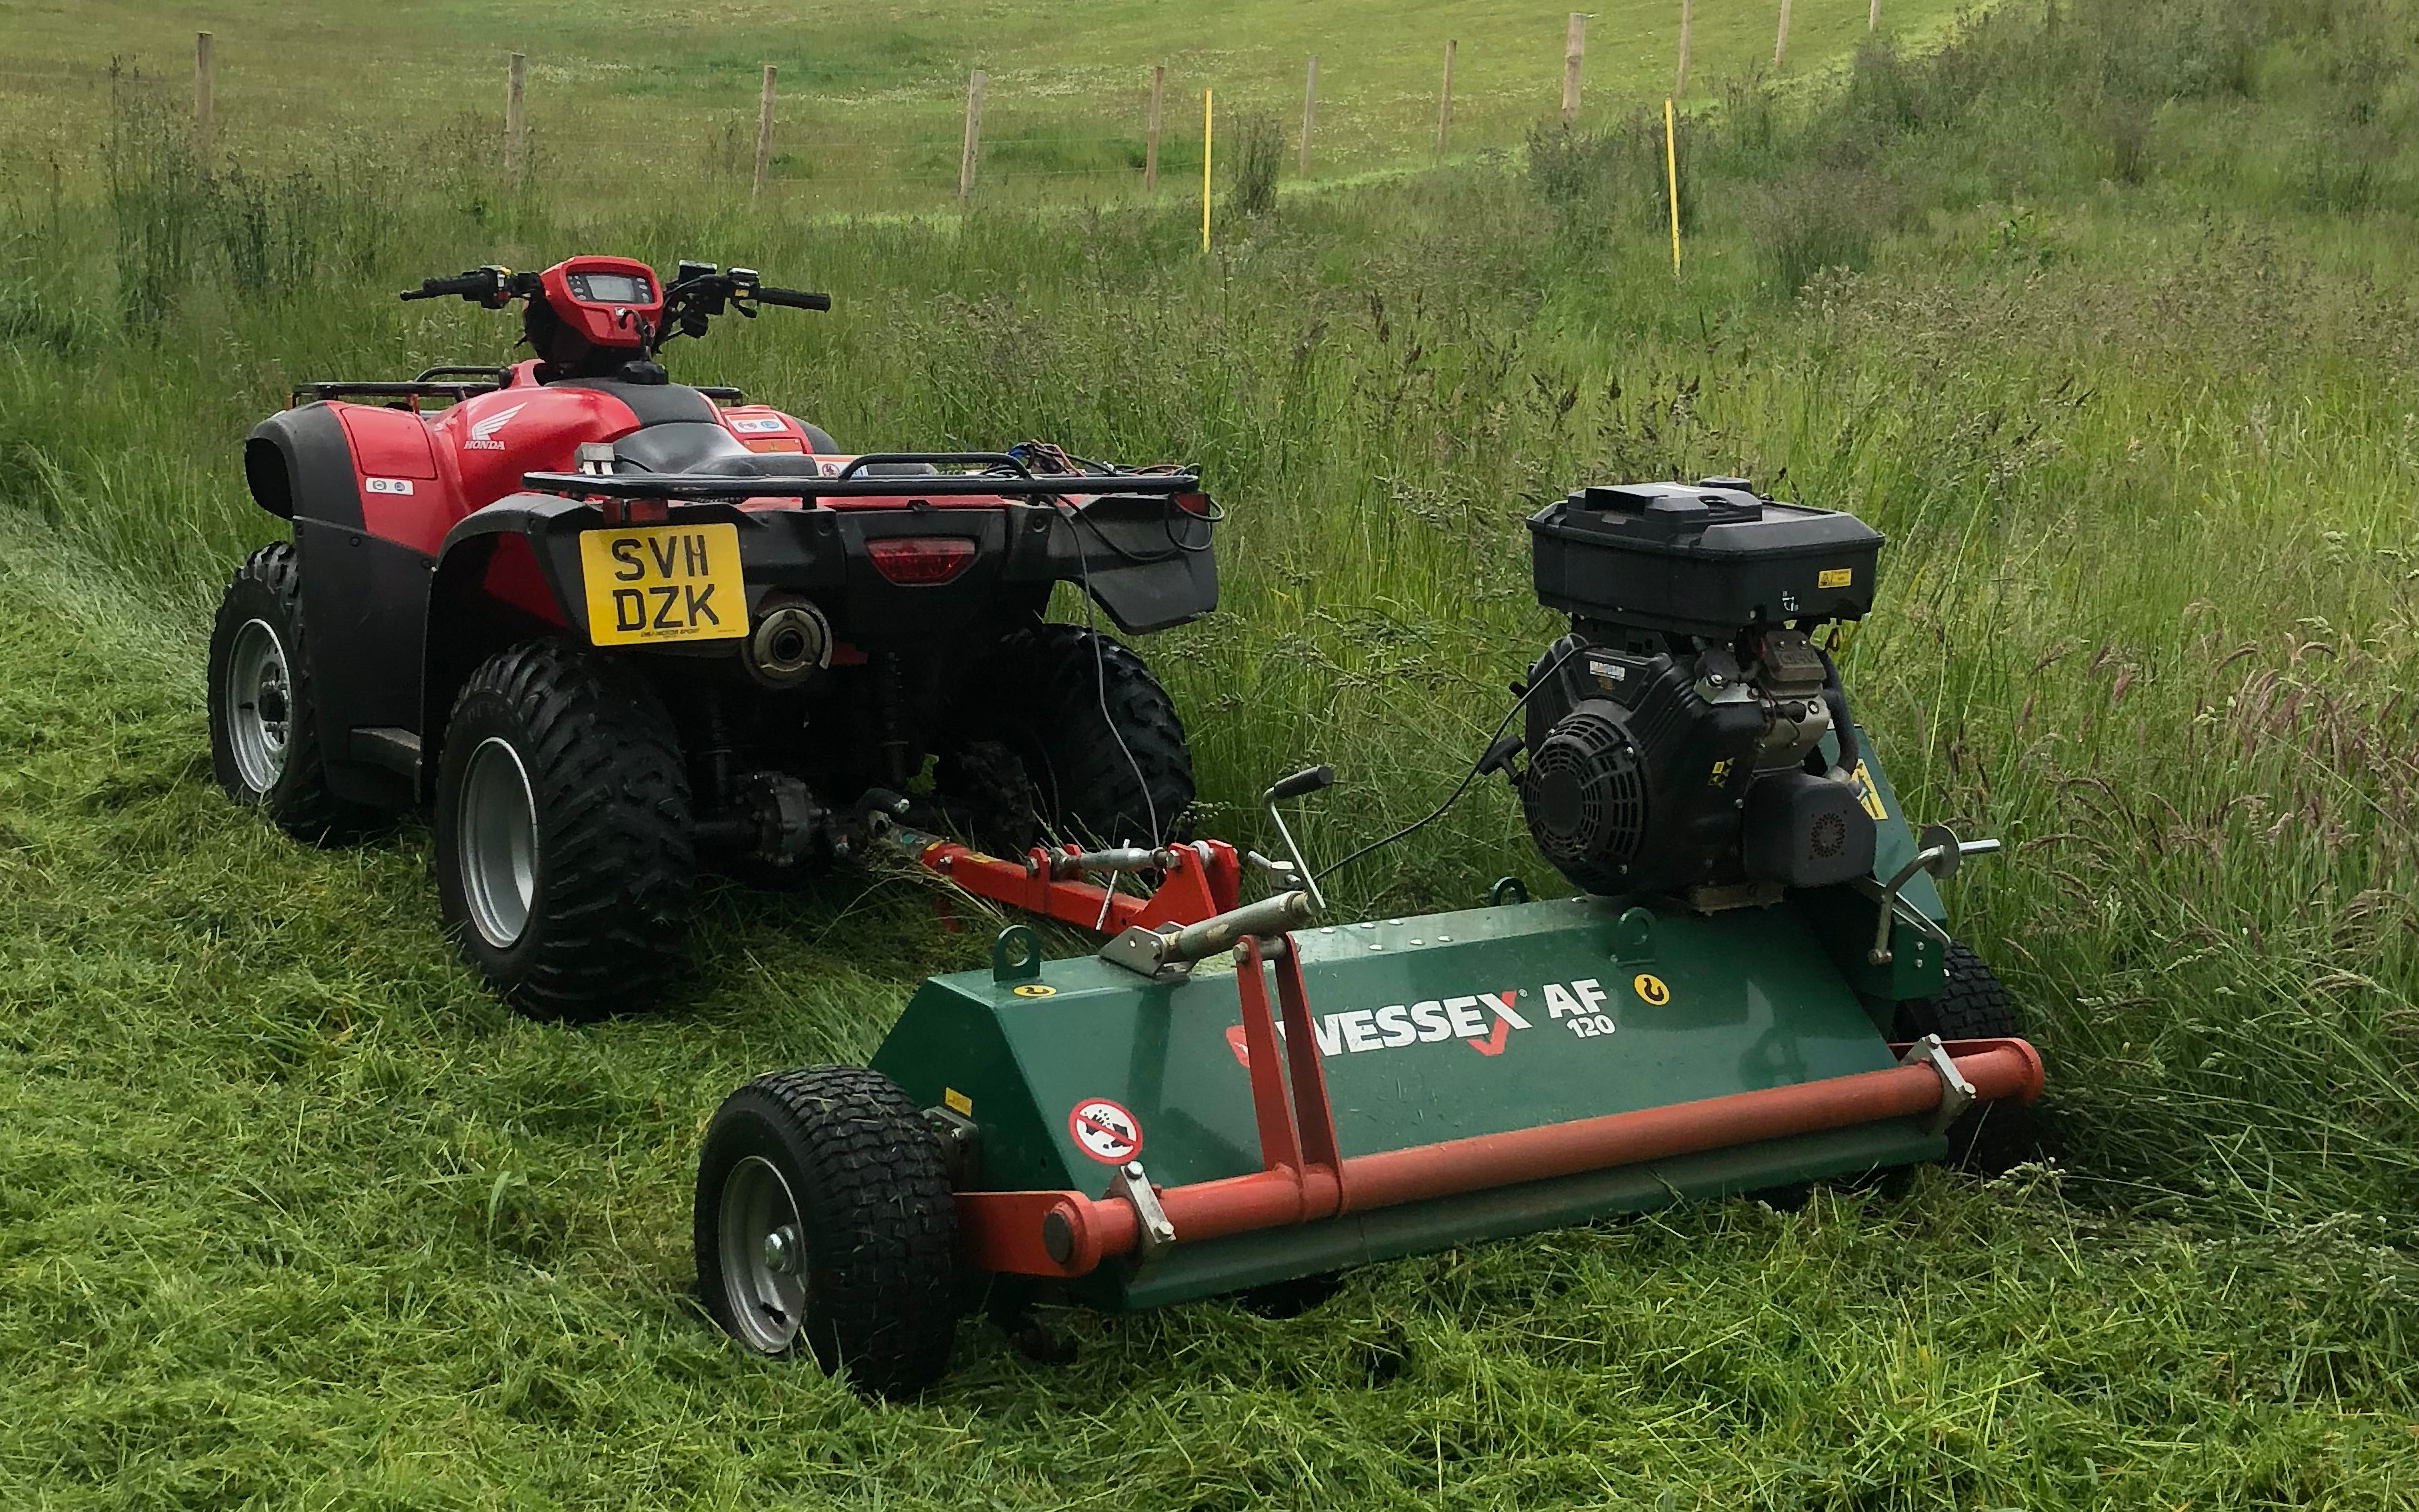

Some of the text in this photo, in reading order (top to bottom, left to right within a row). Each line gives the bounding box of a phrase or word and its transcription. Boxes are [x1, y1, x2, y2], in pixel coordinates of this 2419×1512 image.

[463, 440, 506, 451] HONDA
[611, 534, 709, 582] SV11
[612, 583, 720, 632] DZK
[1275, 978, 1608, 1057] WESSEX AF
[1566, 1014, 1616, 1038] 120
